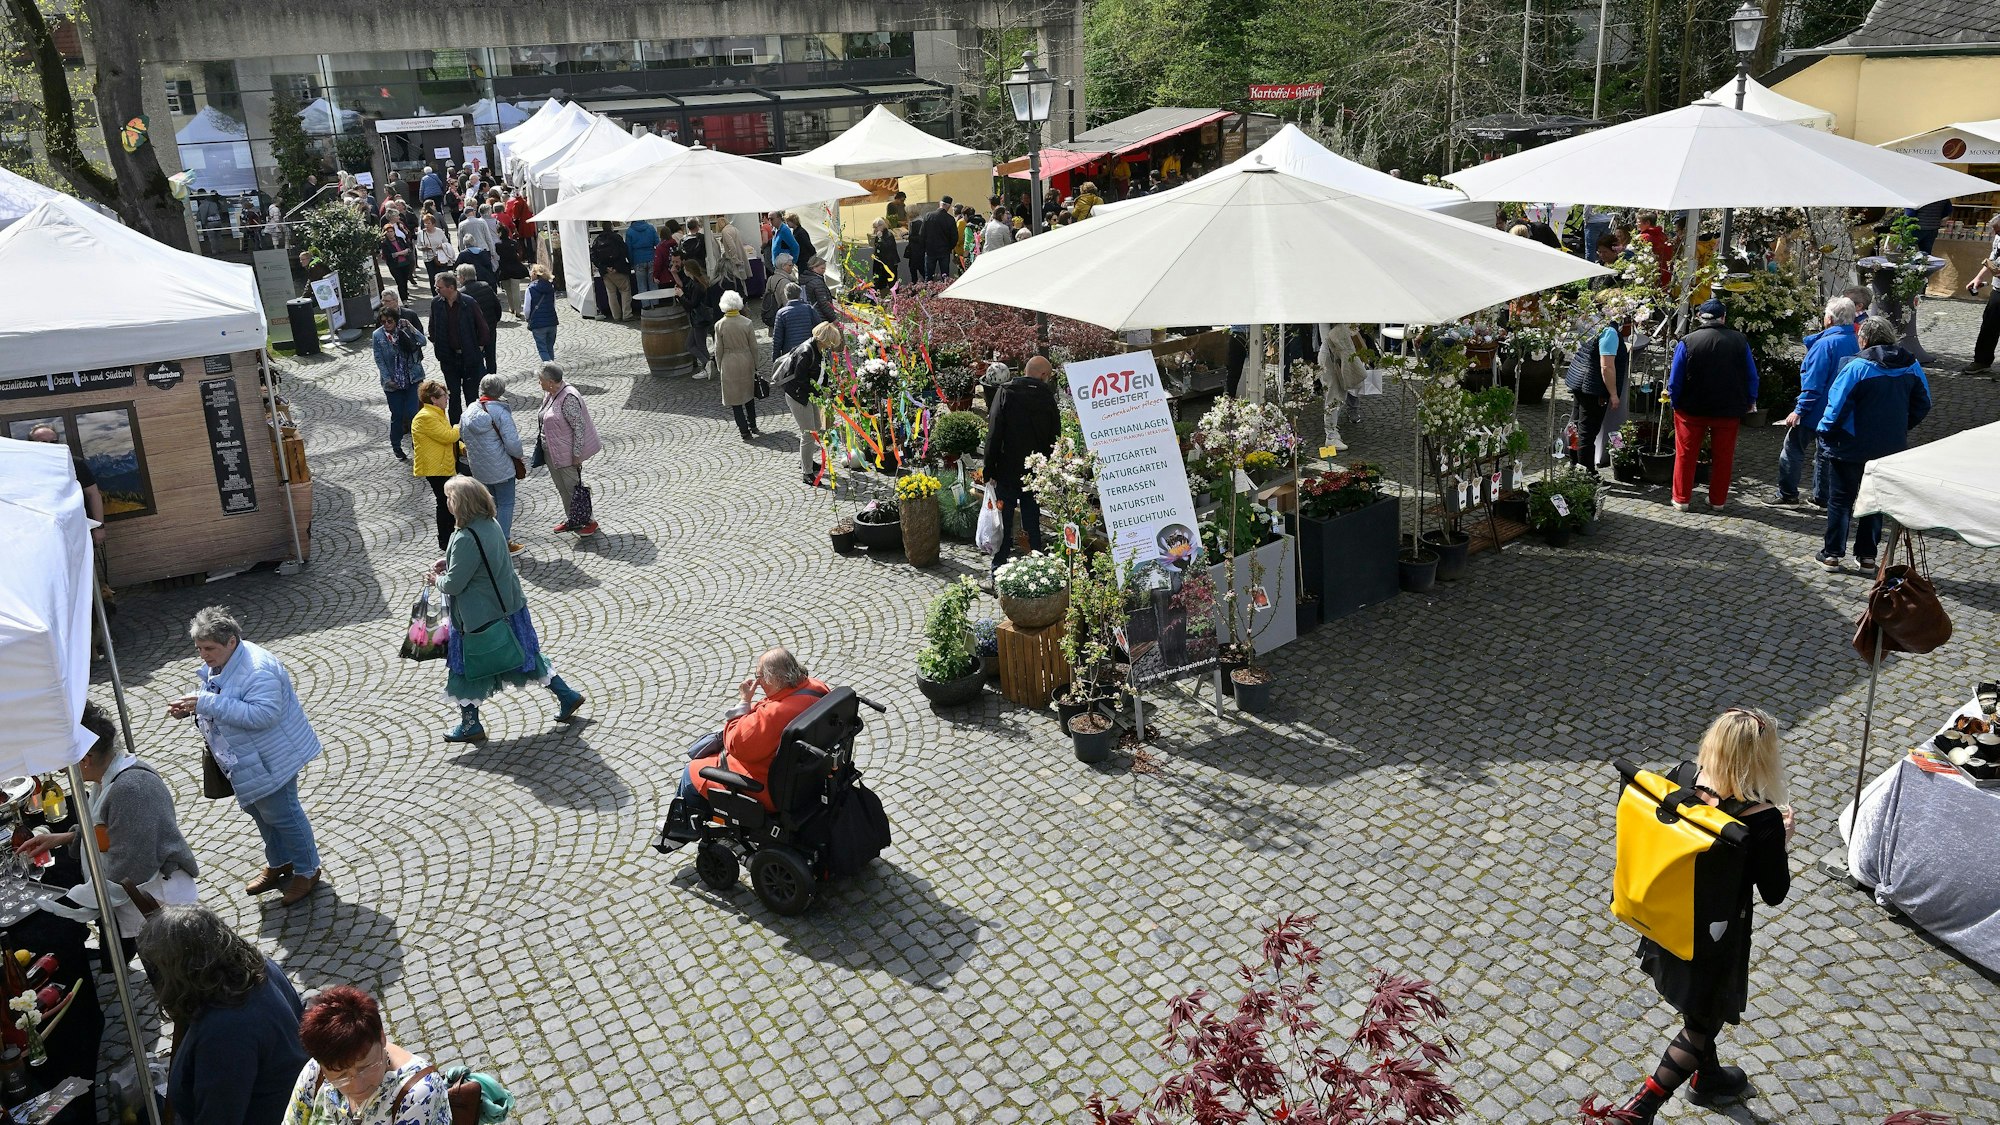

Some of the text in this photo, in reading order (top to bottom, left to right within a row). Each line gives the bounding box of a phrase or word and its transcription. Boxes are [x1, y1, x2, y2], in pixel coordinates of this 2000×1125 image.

[91, 372, 104, 382] und
[105, 367, 133, 381] Südtirol
[1091, 390, 1149, 409] BEGEISTERT
[1090, 417, 1169, 440] GARTENANLAGEN
[1101, 460, 1168, 482] NATURGÄRTEN
[1105, 479, 1157, 497] TERRASSEN
[1109, 493, 1165, 513] NATURSTEIN
[1112, 507, 1177, 530] BELEUCHTUNG
[1139, 656, 1217, 683] www.garten-begeistert.de
